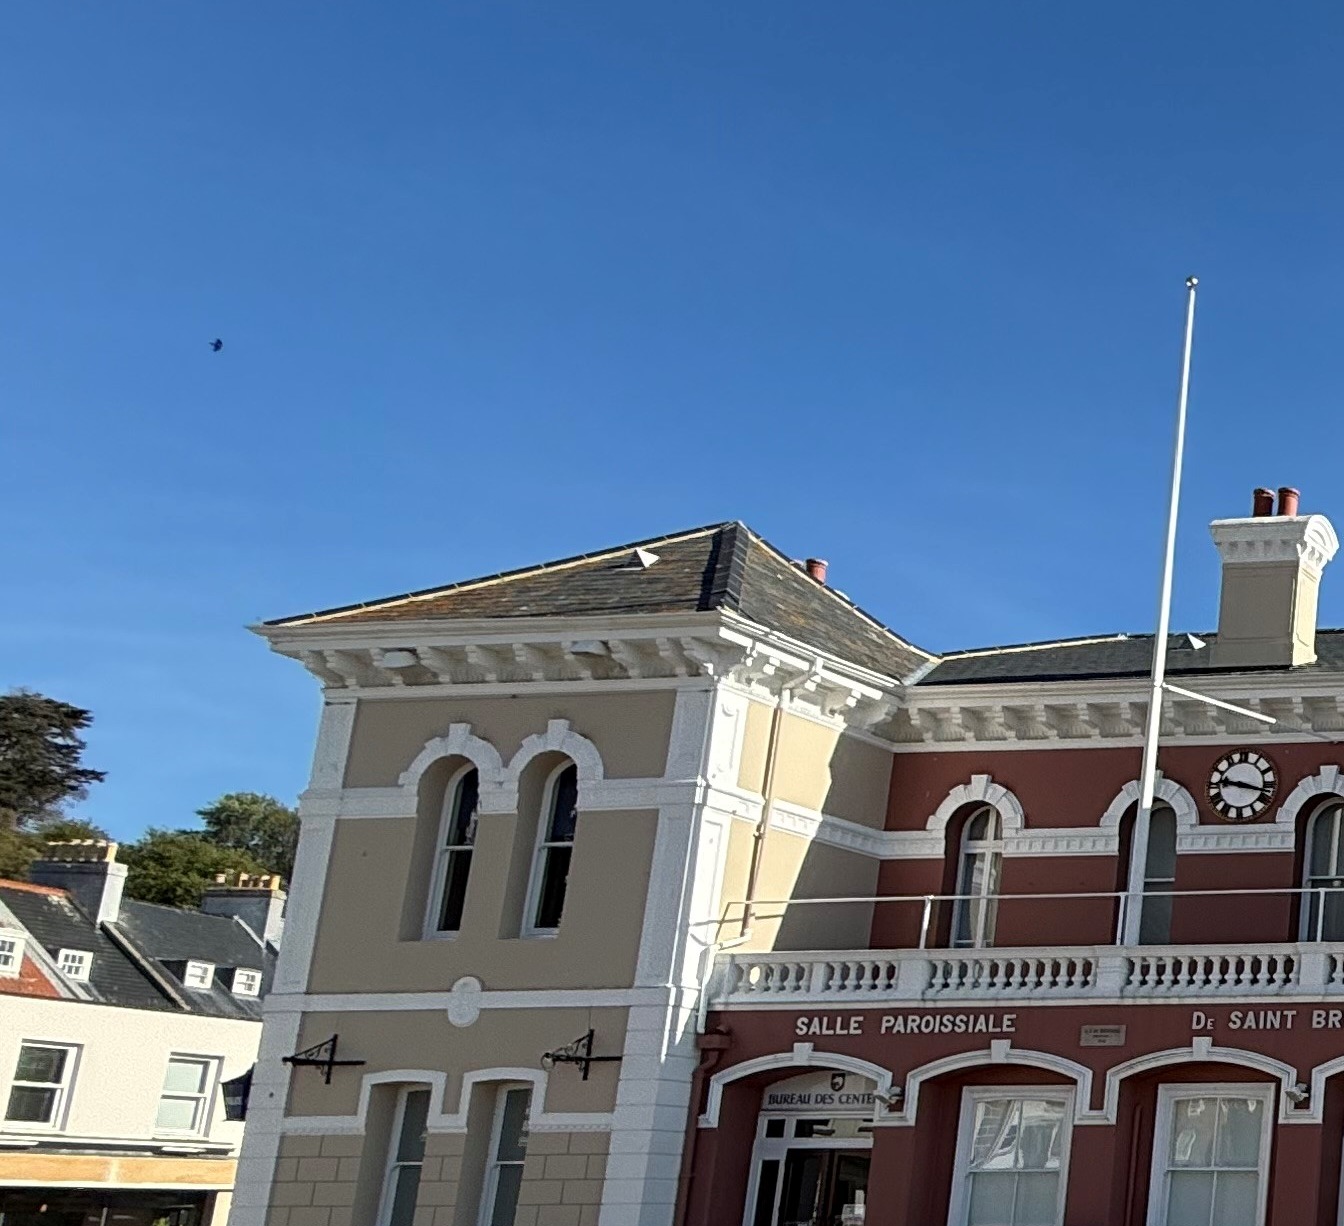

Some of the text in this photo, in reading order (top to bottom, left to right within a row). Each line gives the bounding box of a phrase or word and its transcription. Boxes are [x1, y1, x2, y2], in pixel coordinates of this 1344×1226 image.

[795, 1016, 864, 1035] SALLE
[880, 1014, 1017, 1034] PAROISSIALE
[1228, 1010, 1297, 1029] SAINT
[768, 1093, 877, 1105] BUREAU DES CENTE
